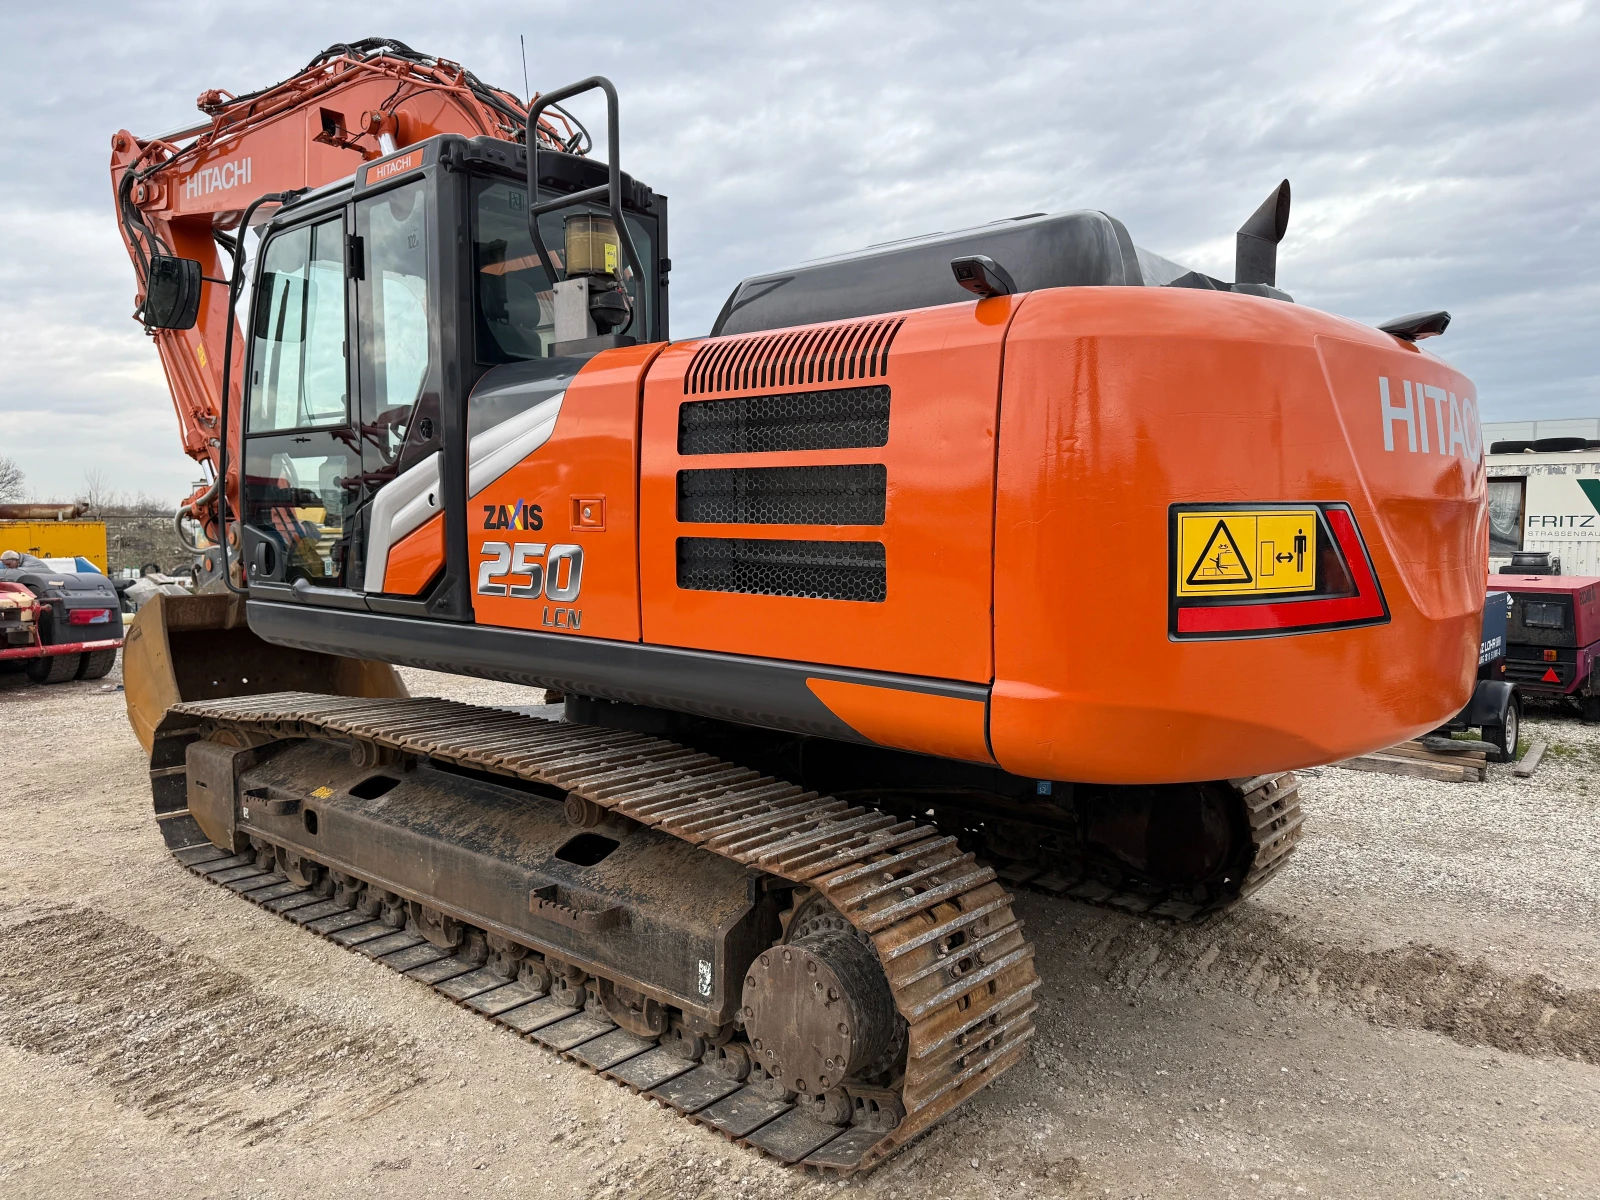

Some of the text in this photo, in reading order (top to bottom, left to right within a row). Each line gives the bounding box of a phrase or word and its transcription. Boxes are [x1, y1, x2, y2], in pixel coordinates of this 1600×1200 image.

[186, 157, 252, 200] HITACHI
[377, 156, 412, 179] HITACHI
[483, 498, 544, 531] ZAXIS
[1528, 515, 1595, 528] FRITZ
[477, 541, 585, 603] 250
[541, 606, 583, 630] LCN
